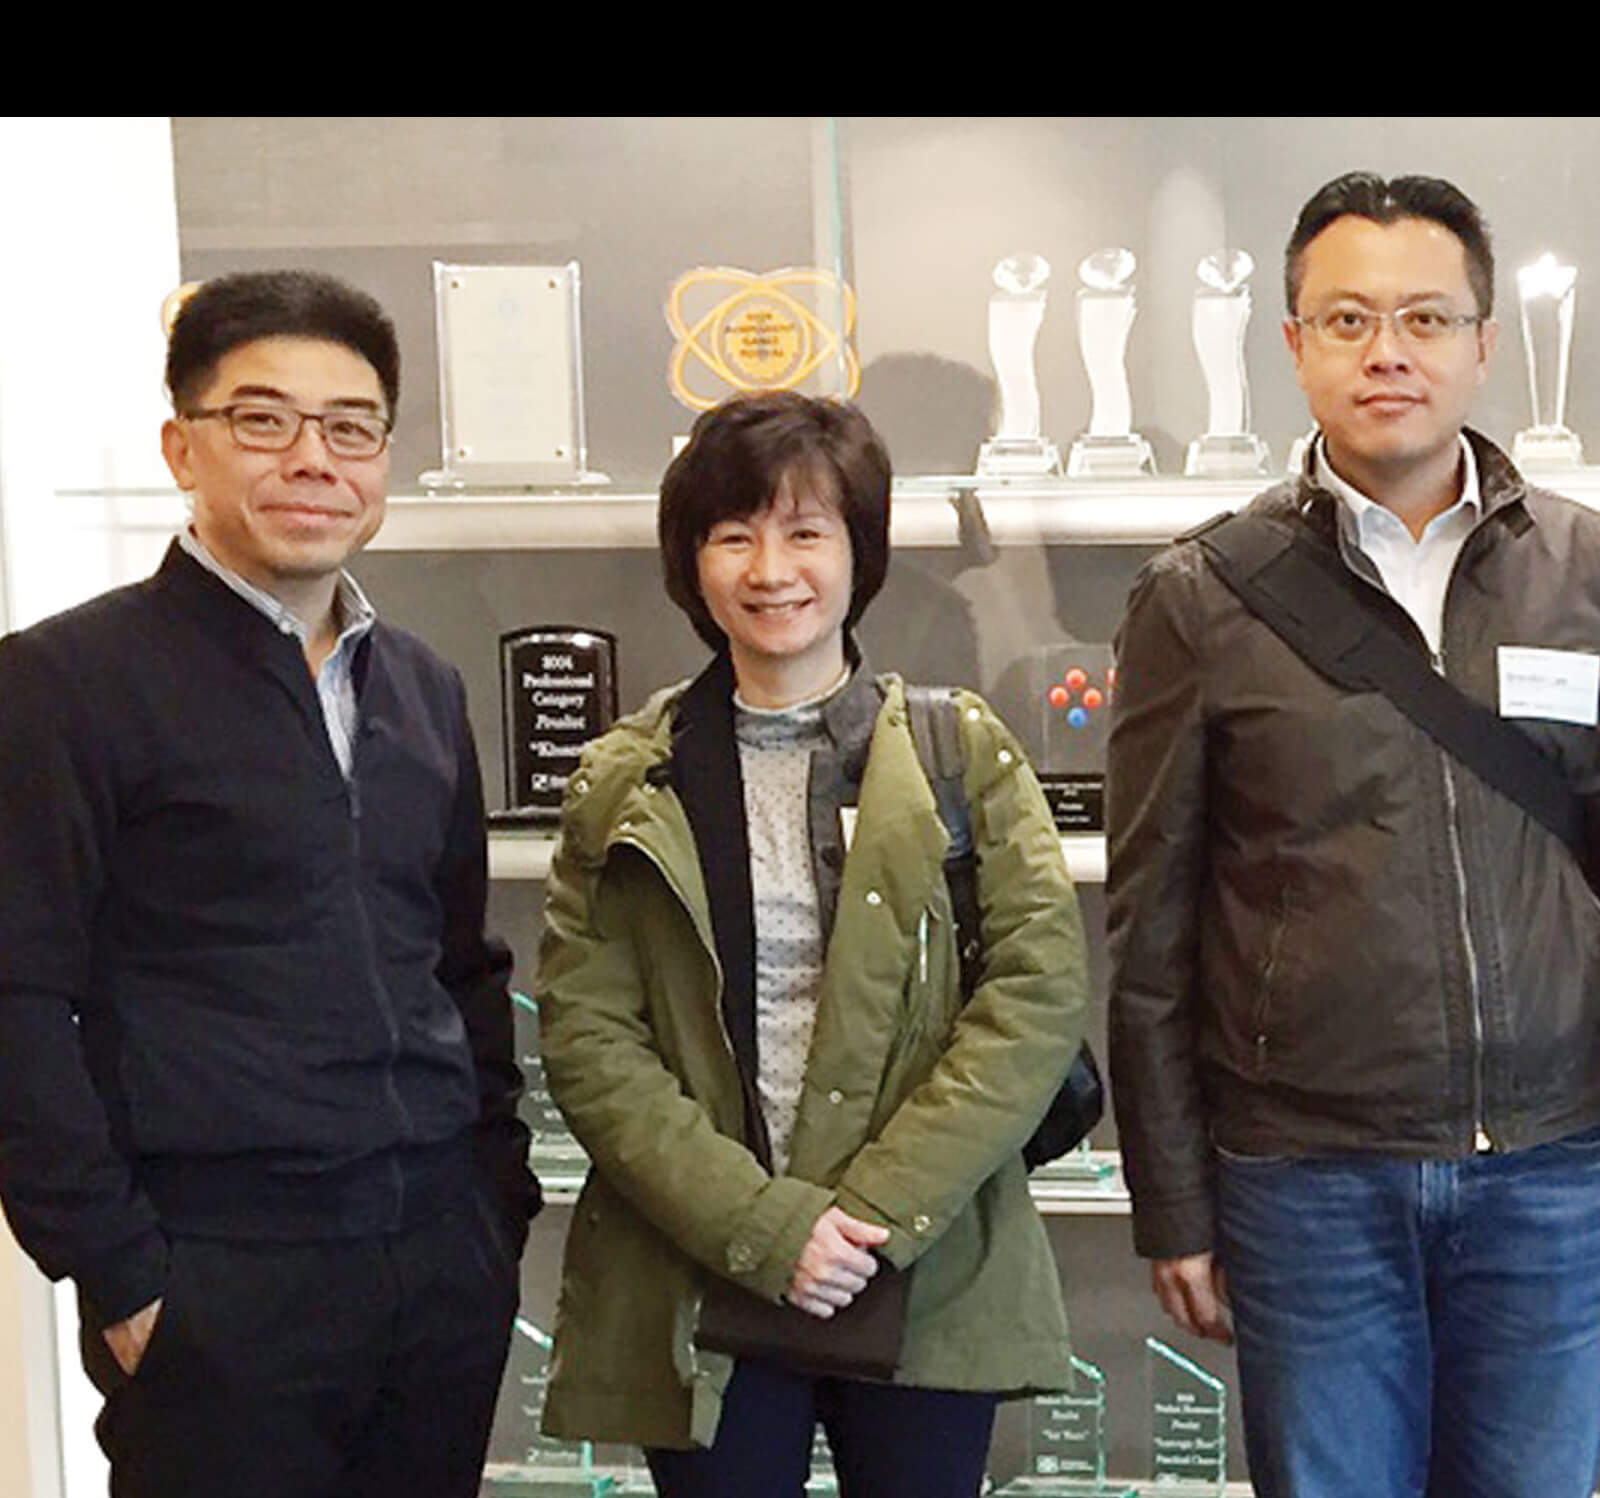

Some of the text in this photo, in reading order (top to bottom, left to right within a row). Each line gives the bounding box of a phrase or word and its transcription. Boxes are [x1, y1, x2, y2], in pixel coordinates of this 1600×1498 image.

[523, 672, 595, 688] Professional
[532, 691, 586, 709] Category
[535, 714, 586, 730] Finalist
